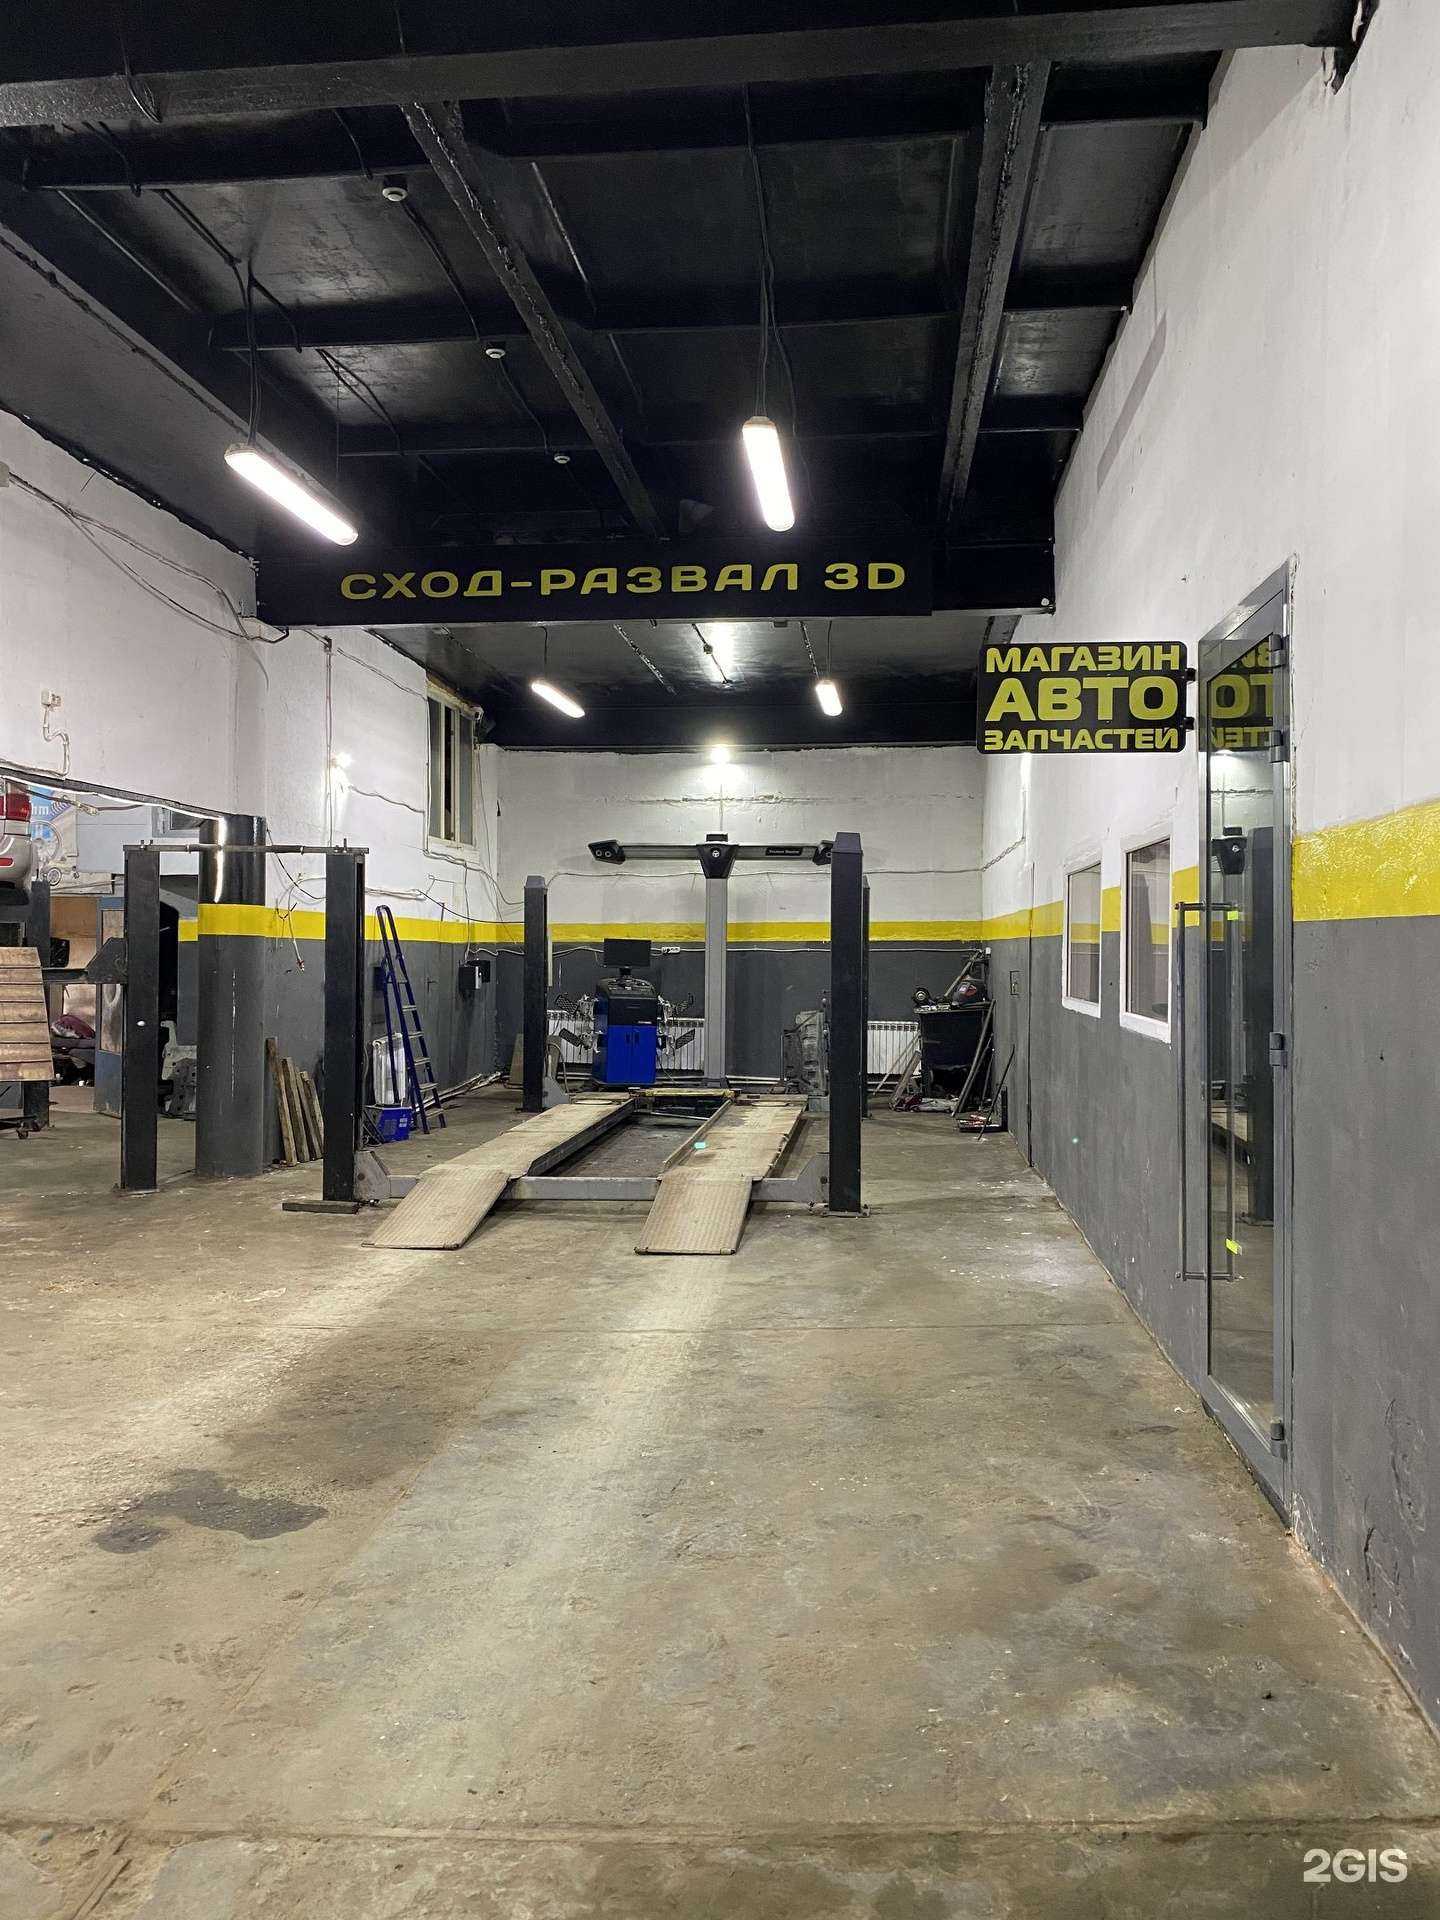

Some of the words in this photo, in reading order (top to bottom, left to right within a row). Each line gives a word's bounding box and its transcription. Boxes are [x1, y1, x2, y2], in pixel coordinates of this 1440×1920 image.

[340, 562, 799, 600] СХОД-РАЗВАЛ
[824, 561, 906, 592] 3D
[985, 644, 1181, 673] МАГАЗИН
[984, 675, 1179, 723] АВТО
[984, 726, 1179, 752] ЗАПЧАСТЕЙ
